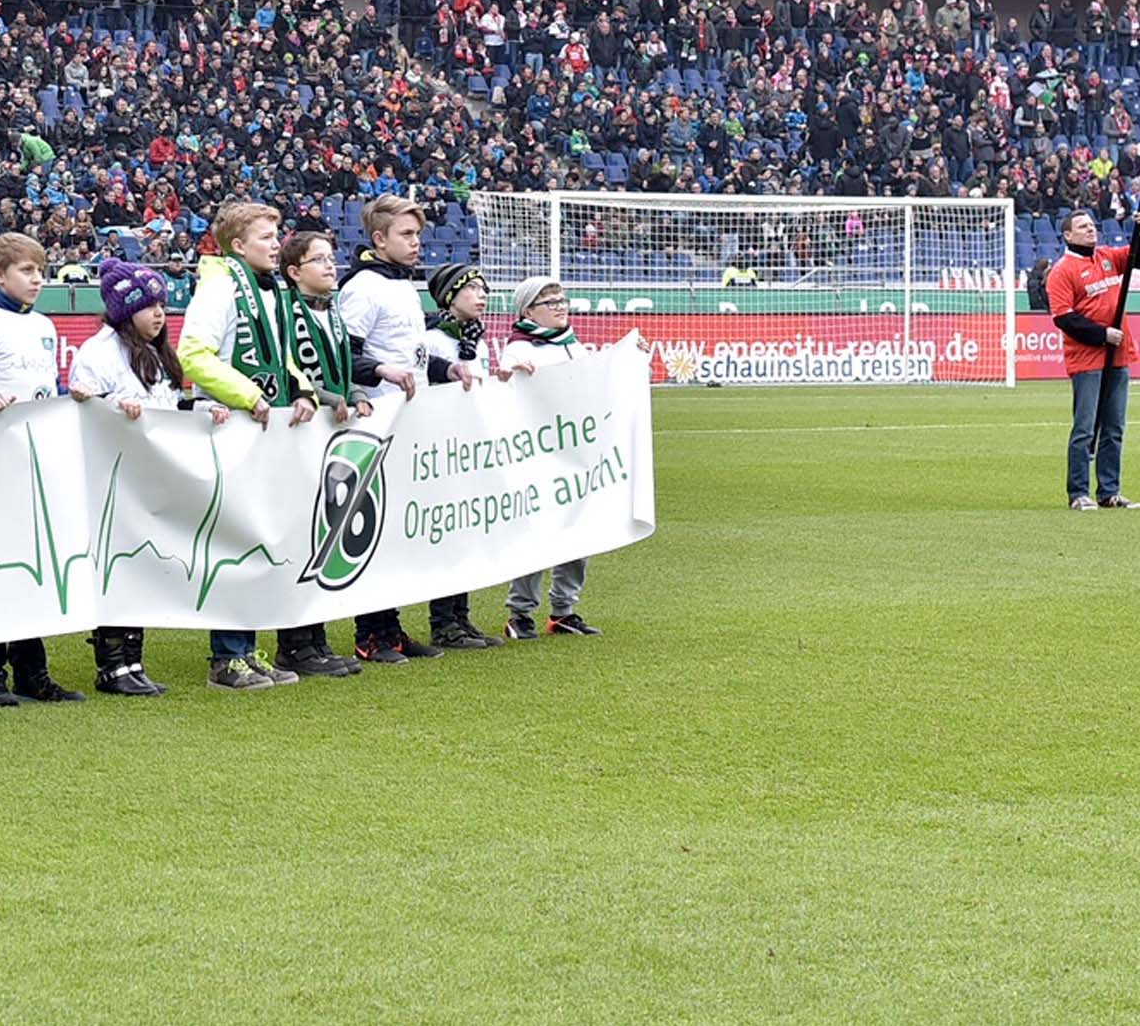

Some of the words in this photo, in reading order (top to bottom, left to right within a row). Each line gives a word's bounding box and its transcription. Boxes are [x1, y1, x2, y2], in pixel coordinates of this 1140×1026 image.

[700, 354, 853, 379] schauinsland
[861, 354, 929, 378] reisen
[412, 442, 439, 482] ist
[554, 446, 628, 505] auch!
[309, 437, 386, 576] 96
